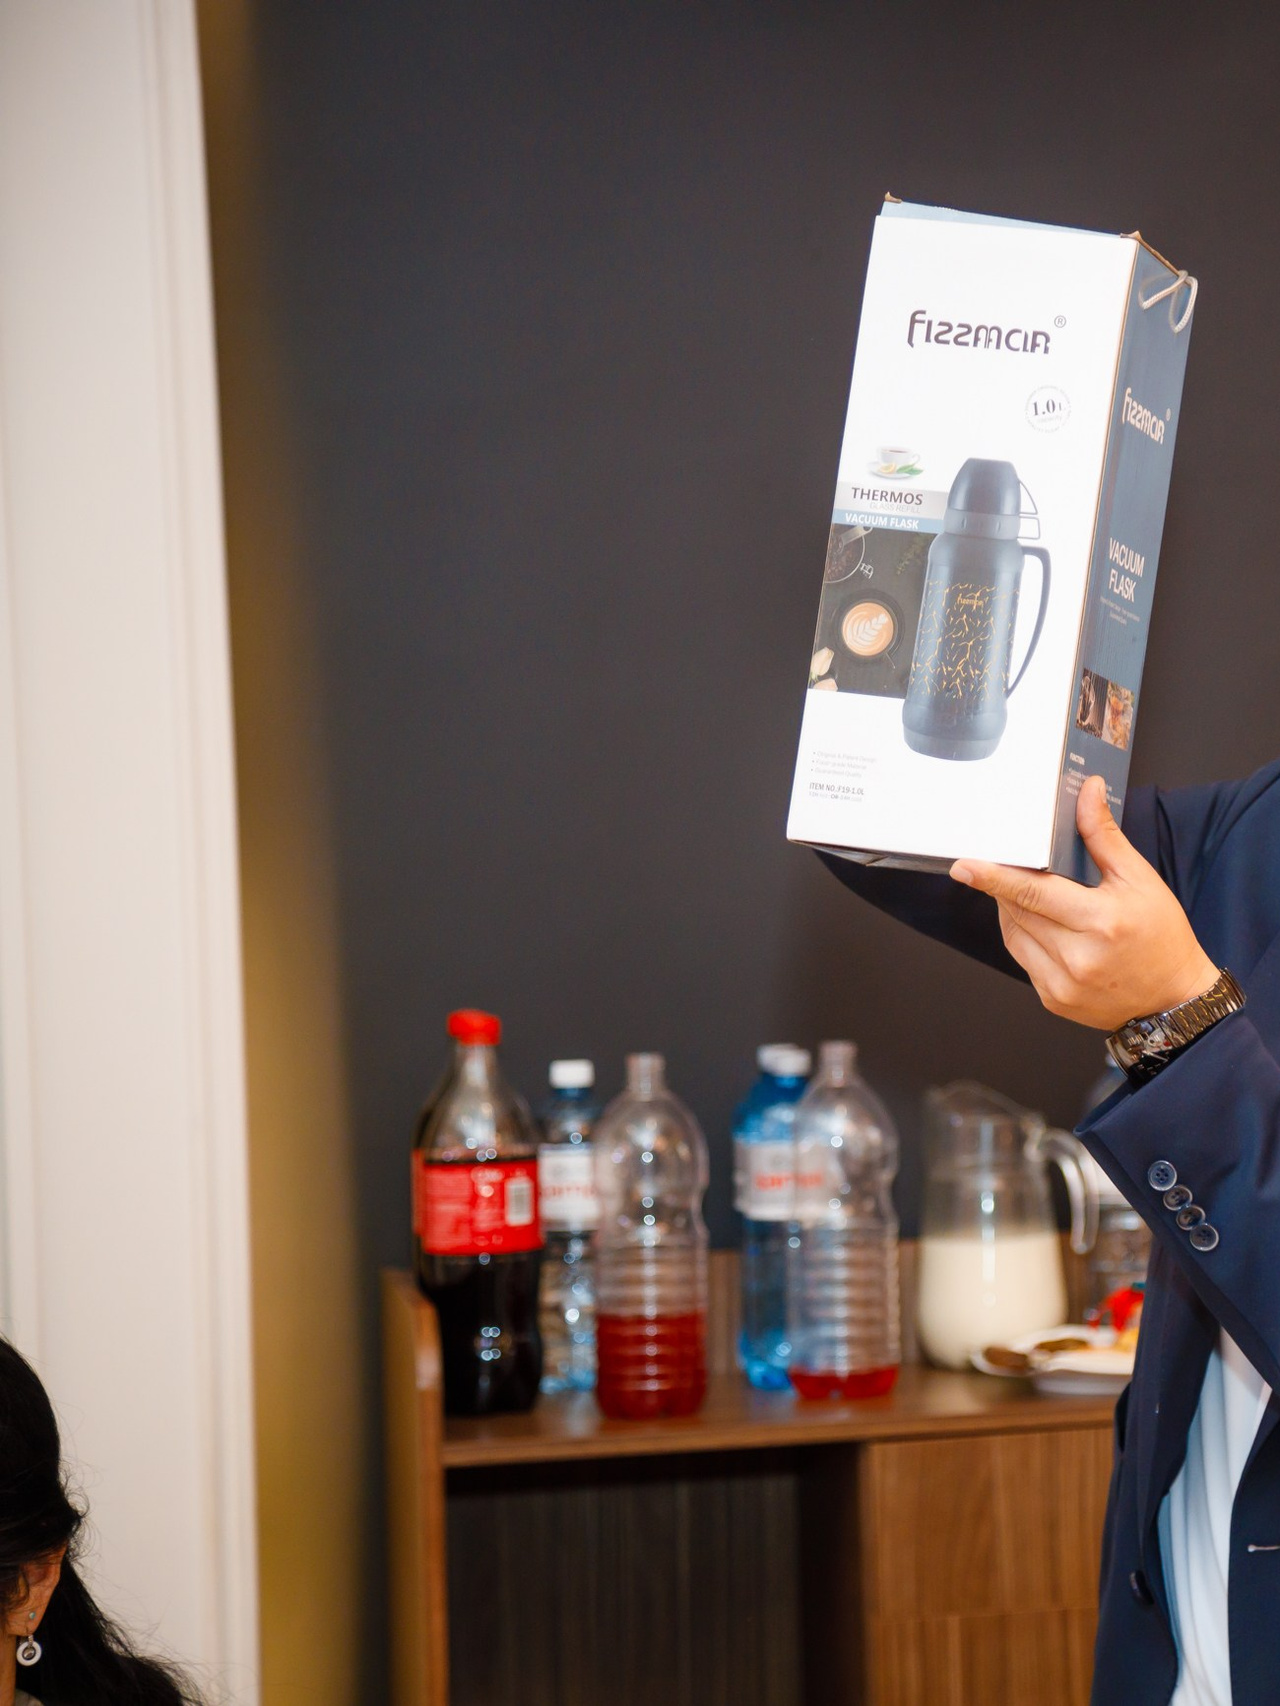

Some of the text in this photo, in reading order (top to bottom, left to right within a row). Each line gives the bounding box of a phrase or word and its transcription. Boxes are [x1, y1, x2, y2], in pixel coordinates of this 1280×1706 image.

[1033, 399, 1056, 416] 1.0
[851, 487, 924, 506] THERMOS
[845, 513, 920, 530] VACUUM FLASK
[1109, 537, 1145, 578] VACUUM
[1108, 568, 1137, 603] FLASK
[809, 782, 825, 791] ITEM
